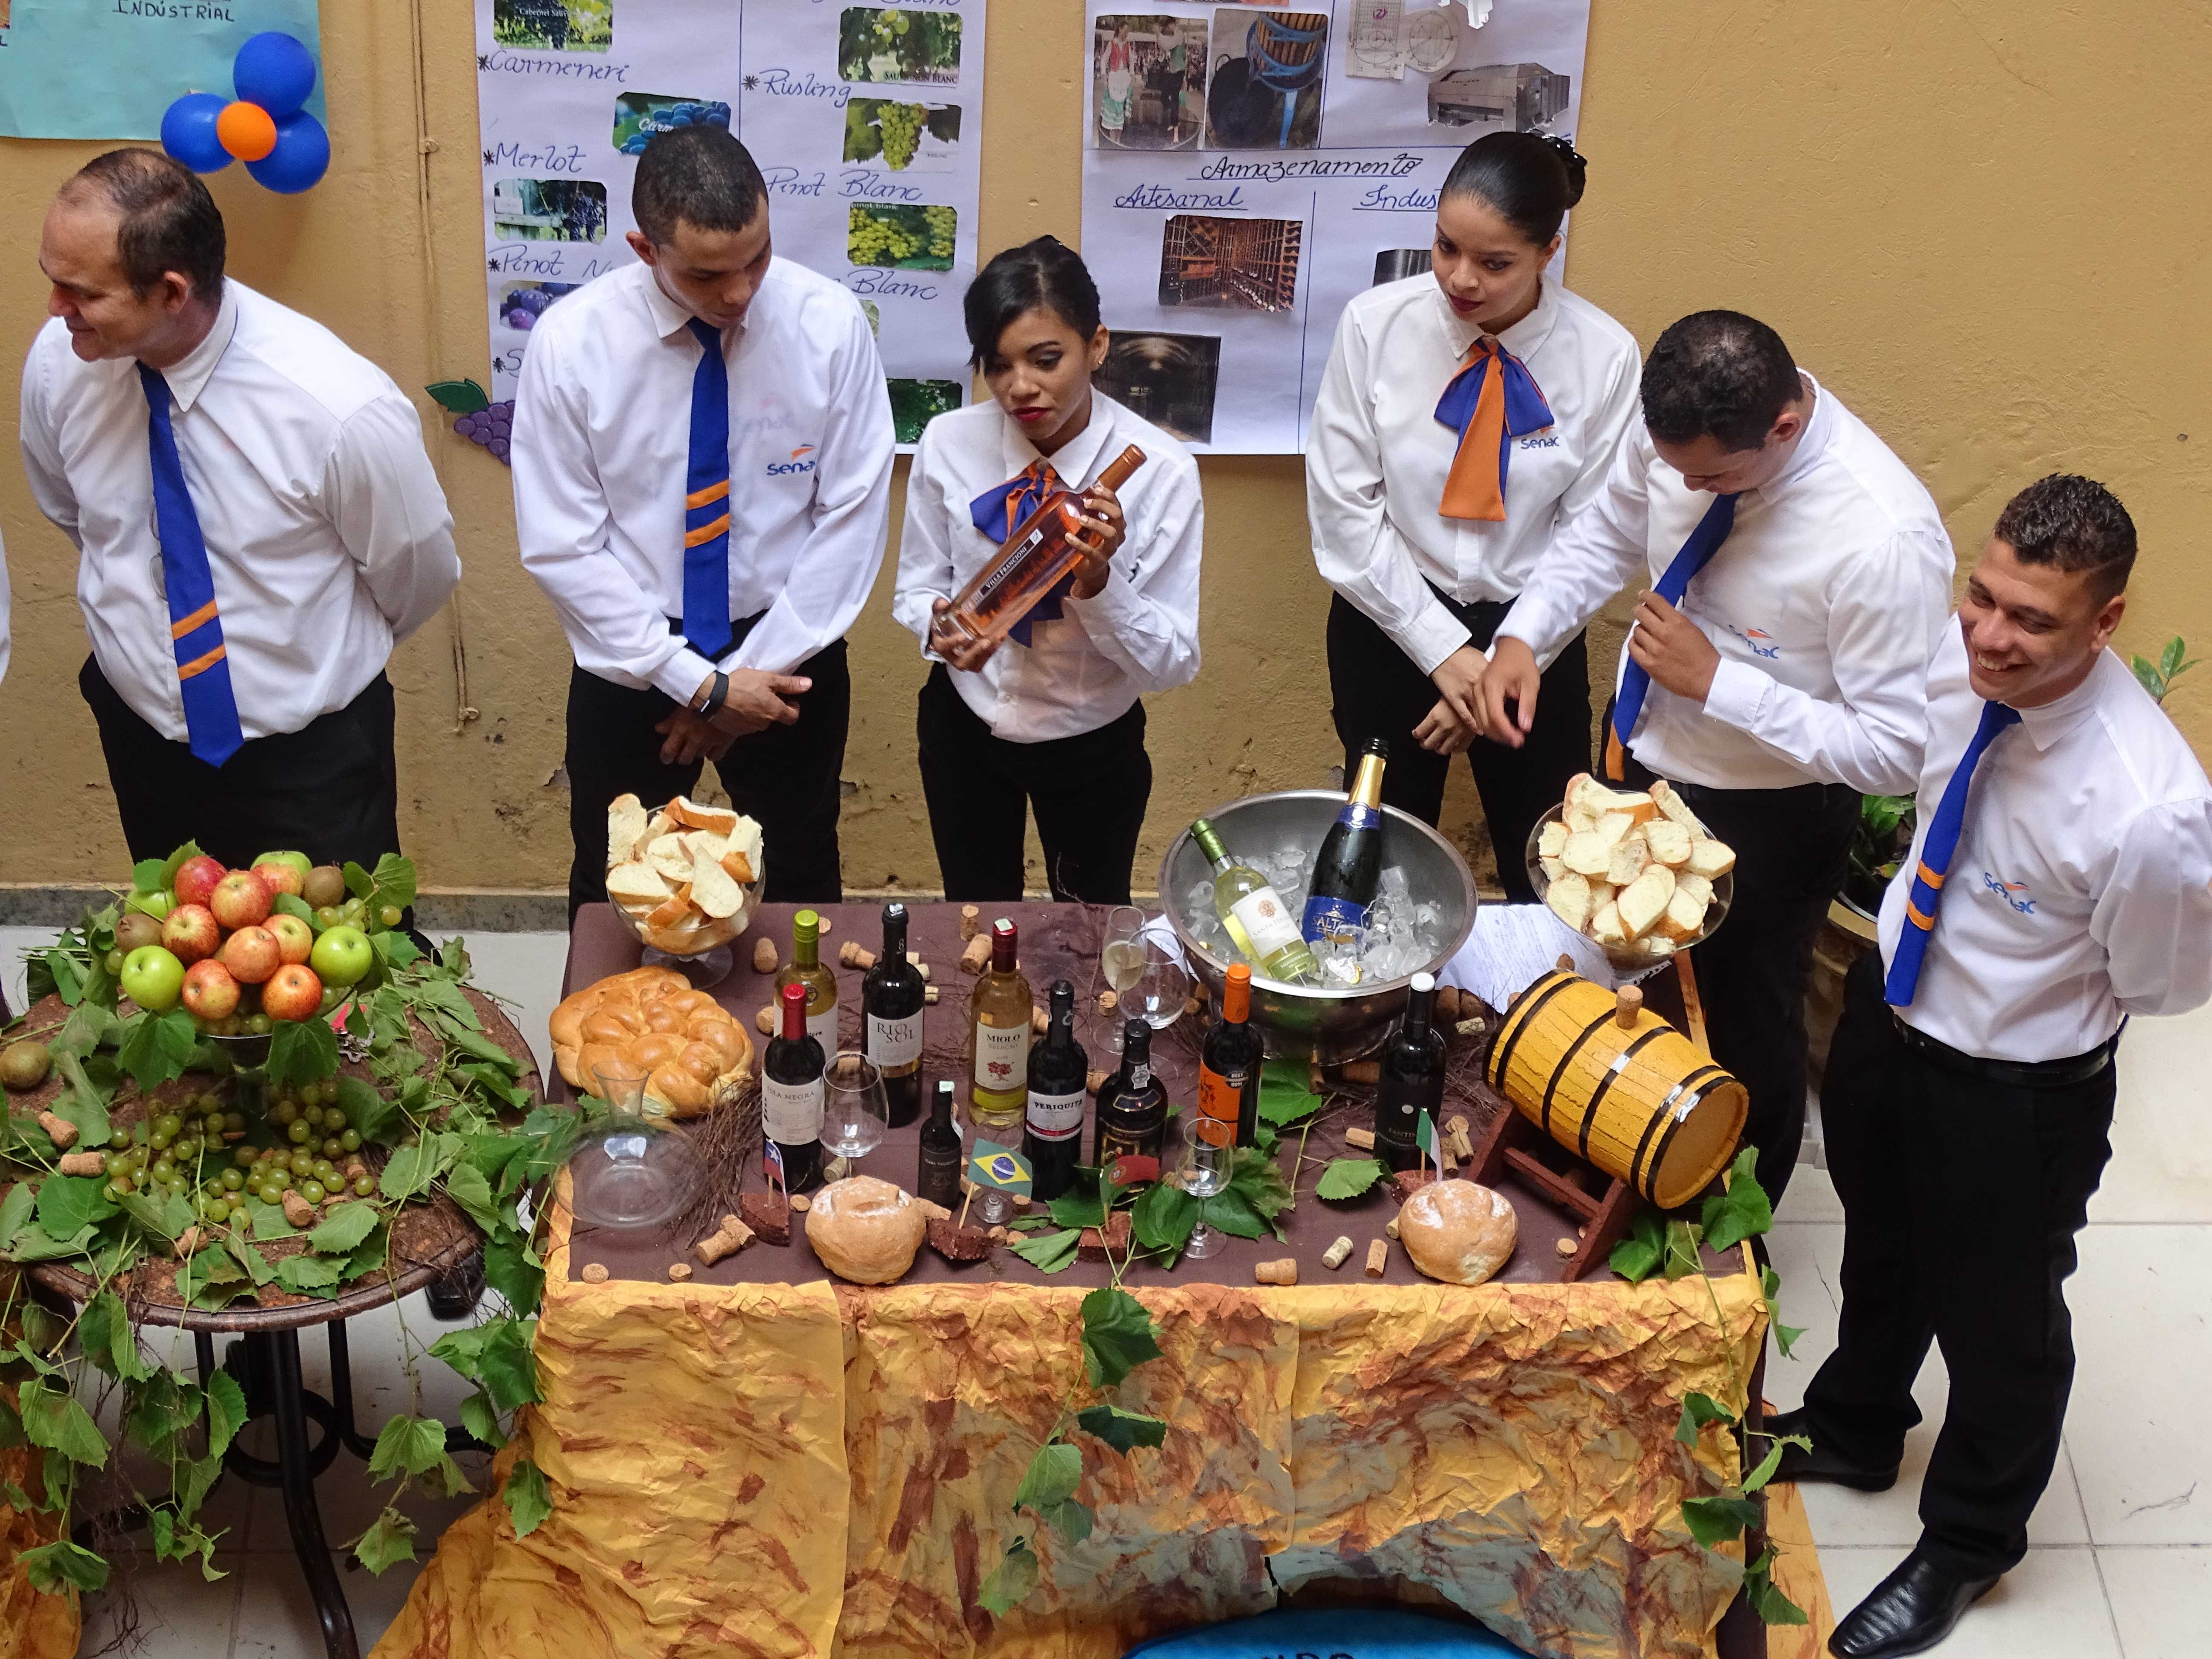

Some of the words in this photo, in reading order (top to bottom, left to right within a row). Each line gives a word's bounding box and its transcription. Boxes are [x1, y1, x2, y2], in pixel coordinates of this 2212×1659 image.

[932, 74, 957, 84] BLANC
[638, 117, 674, 133] Carm
[494, 142, 586, 173] Merlot
[760, 167, 826, 197] Pinot
[838, 169, 923, 201] Blanc
[1115, 184, 1243, 208] Artesanal
[1360, 185, 1442, 209] Indus
[489, 244, 565, 276] Pinot
[848, 269, 938, 300] Blanc
[766, 460, 815, 476] sena
[987, 1034, 1020, 1043] MIOLO
[785, 1091, 815, 1100] NEGRA
[1034, 1099, 1083, 1110] PERIQUITA
[1389, 1127, 1417, 1138] FANTIN
